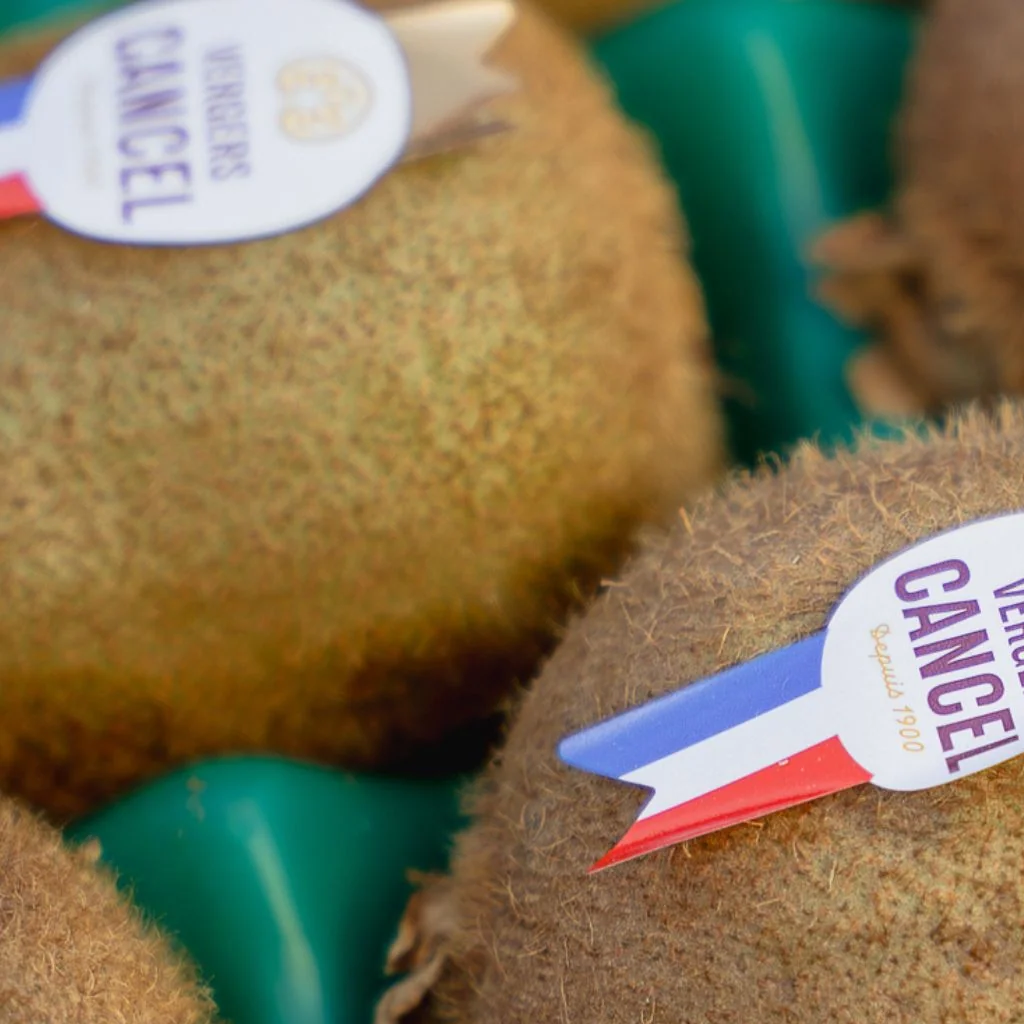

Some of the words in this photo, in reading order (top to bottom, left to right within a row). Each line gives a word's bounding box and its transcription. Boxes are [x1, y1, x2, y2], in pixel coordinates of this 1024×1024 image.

[115, 26, 193, 225] CANCEL
[205, 45, 251, 183] VERGERS
[869, 623, 896, 699] Depuis
[892, 704, 925, 753] 1900
[894, 558, 1019, 774] CANCEL
